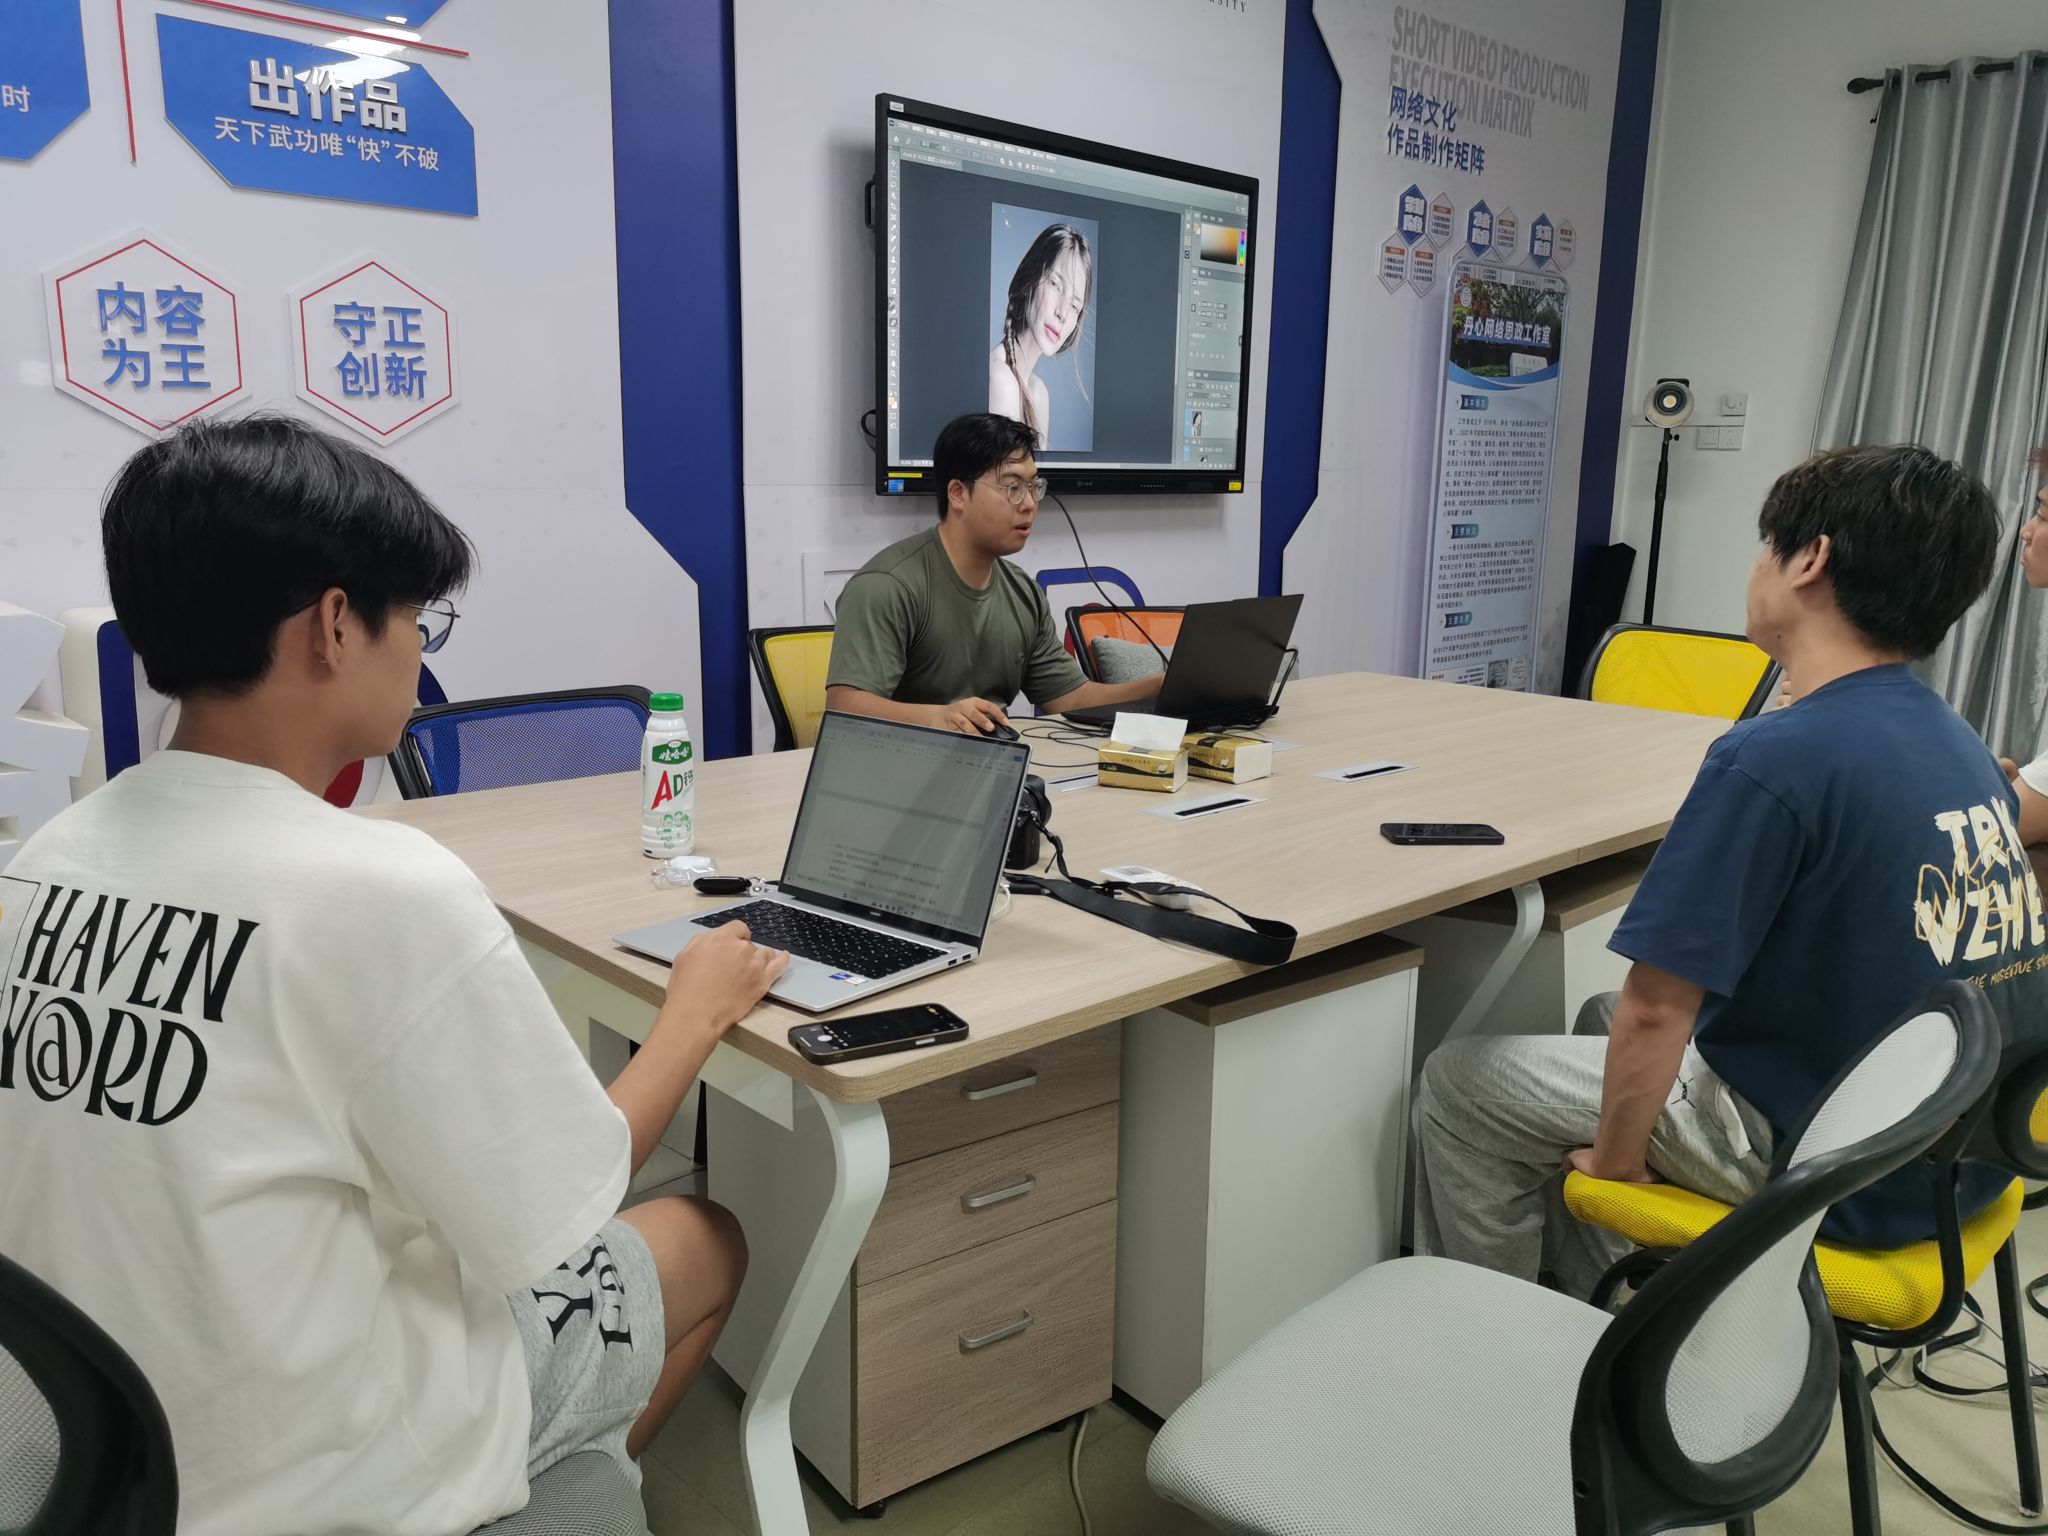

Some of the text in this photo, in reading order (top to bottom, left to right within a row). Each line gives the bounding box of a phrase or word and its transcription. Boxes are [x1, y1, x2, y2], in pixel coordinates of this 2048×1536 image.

[1391, 6, 1591, 111] SHORT VIDEO PRODUCTION
[248, 57, 407, 133] 出作品
[1390, 55, 1536, 138] EXECUTION MATRIX
[1390, 85, 1458, 133] 网络文化
[1386, 122, 1486, 175] 作品制作矩阵
[97, 281, 206, 337] 内容
[333, 301, 426, 351] 守正
[1463, 315, 1551, 345] 丹心网络思政工作室
[102, 338, 211, 391] 为王
[336, 350, 427, 400] 创新
[18, 884, 261, 1022] HAVEN
